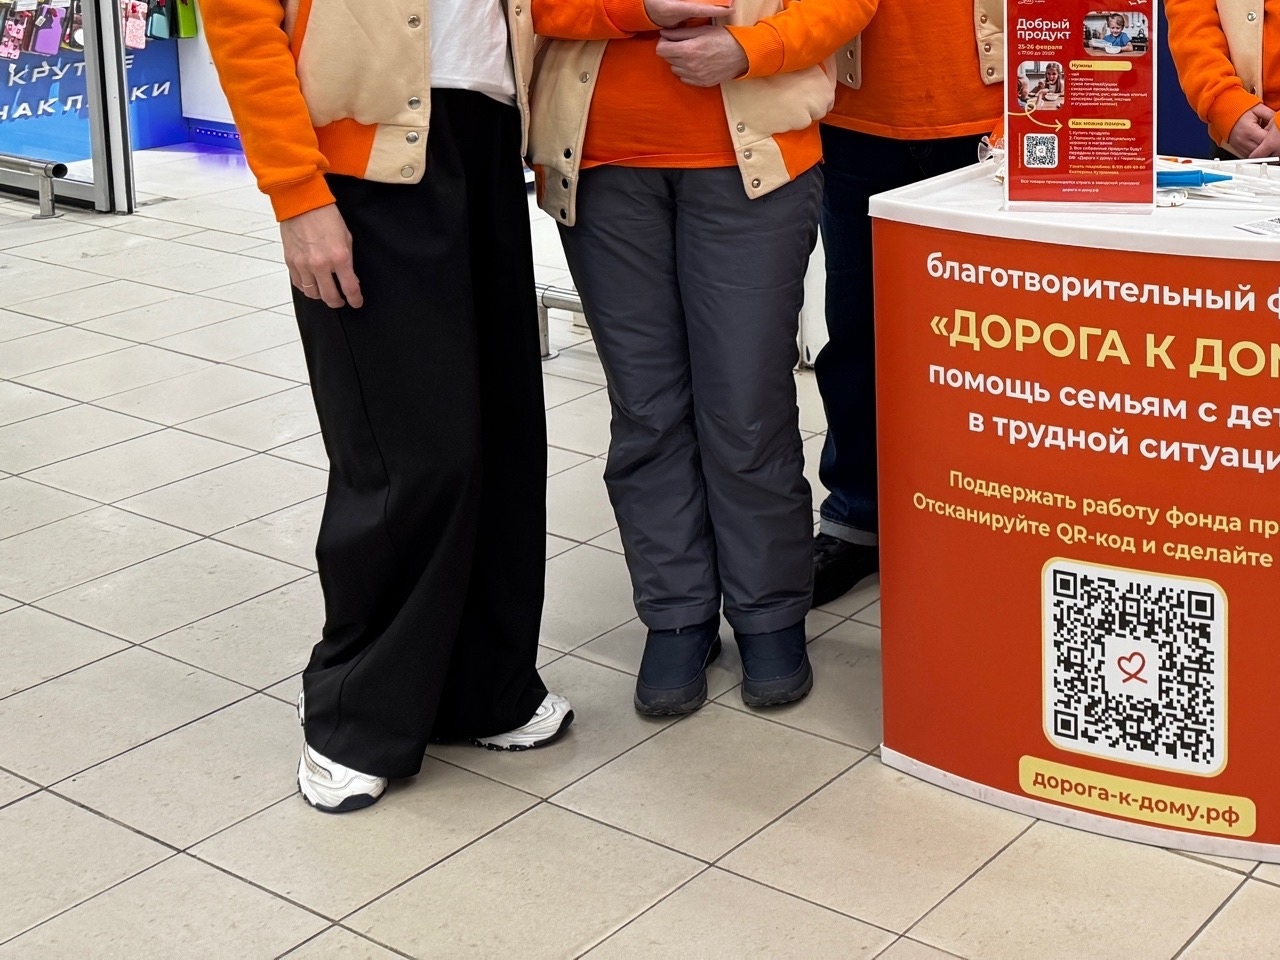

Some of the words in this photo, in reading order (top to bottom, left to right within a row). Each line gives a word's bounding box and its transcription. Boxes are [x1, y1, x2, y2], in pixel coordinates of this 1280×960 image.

[1016, 18, 1070, 30] Добрый
[1017, 30, 1071, 41] продукт
[0, 81, 171, 120] НАКЛКИ
[8, 55, 135, 87] КРУТЕ
[926, 252, 1256, 312] благотворительный
[929, 308, 1130, 365] «ДОРОГА
[1146, 333, 1175, 369] К
[929, 363, 1050, 405] помощь
[1059, 385, 1187, 419] семьям
[1199, 401, 1218, 423] с
[968, 411, 985, 433] в
[993, 413, 1128, 456] трудной
[912, 492, 1050, 538] Отсканируйте
[1056, 523, 1136, 554] QR-код
[1143, 538, 1156, 552] и
[1162, 539, 1273, 569] сделайте
[949, 470, 1077, 511] Поддержать
[1082, 497, 1160, 526] работу
[1165, 503, 1242, 535] фонда
[1032, 767, 1240, 830] дорога-к-дому.рф
